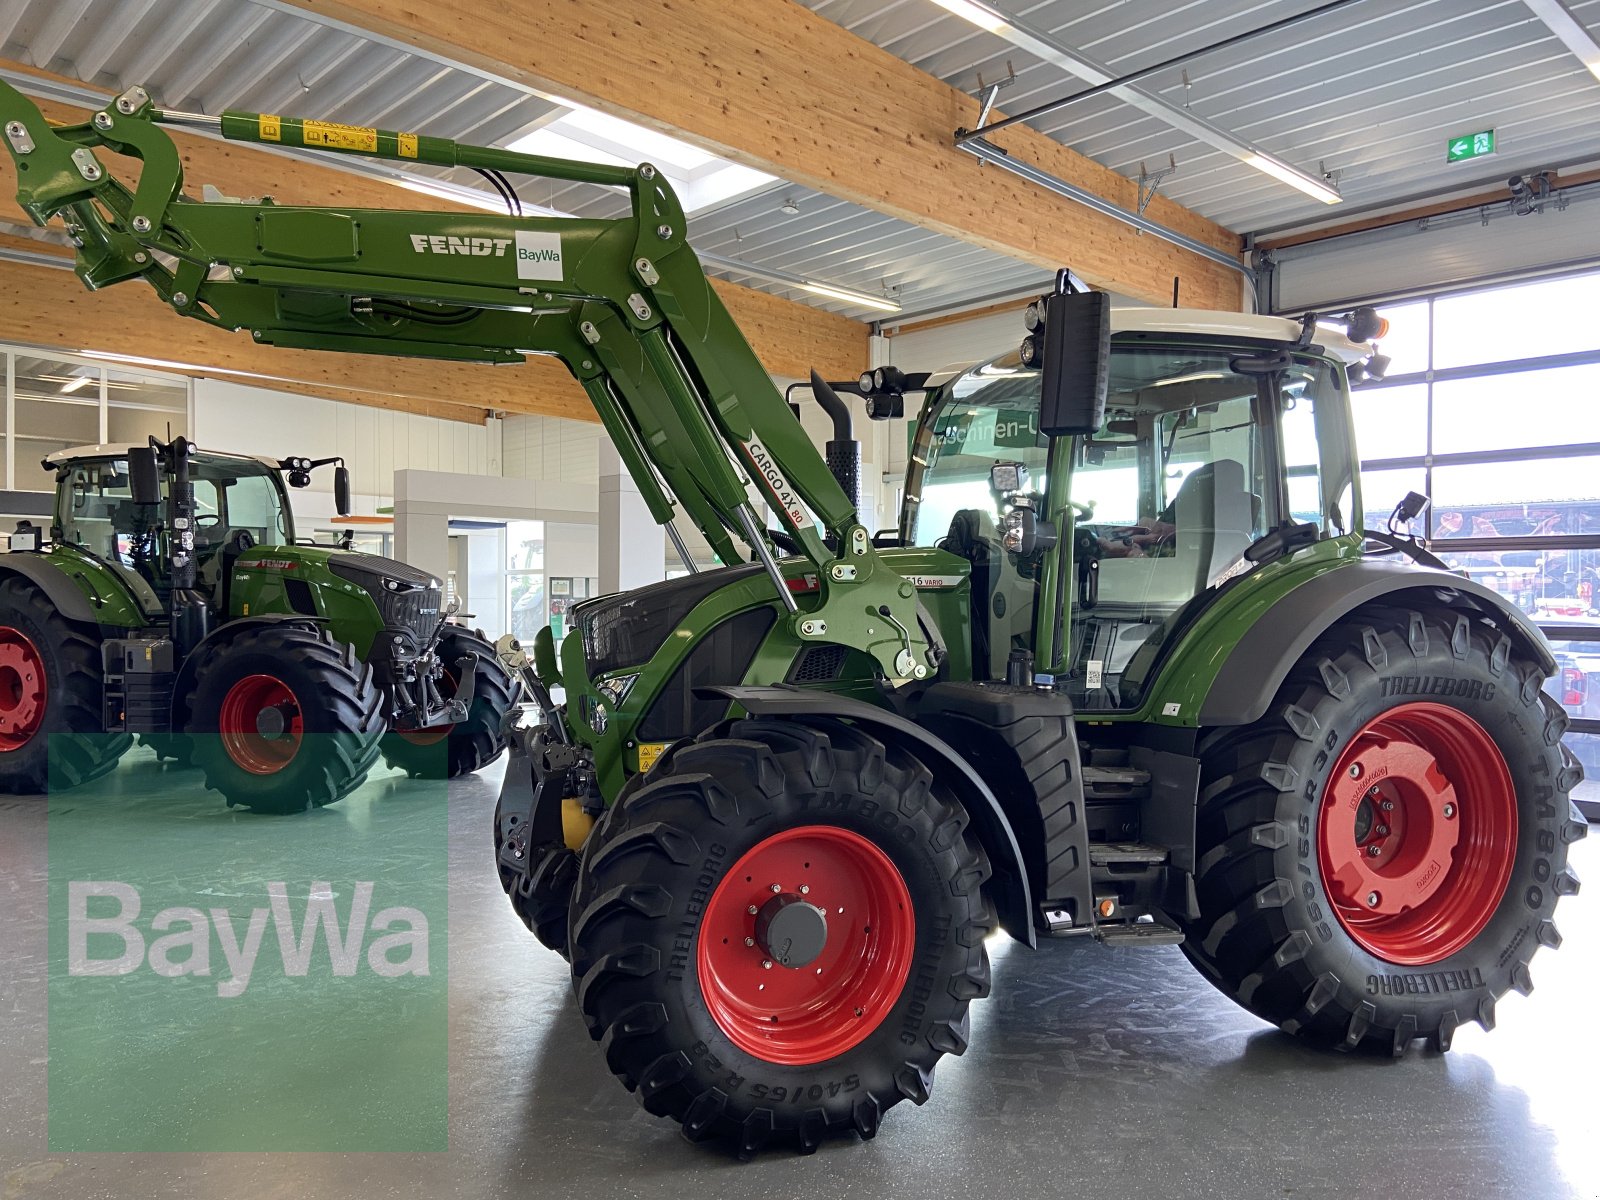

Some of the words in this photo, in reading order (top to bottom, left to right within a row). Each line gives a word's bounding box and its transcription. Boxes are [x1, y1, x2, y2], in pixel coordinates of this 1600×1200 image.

[409, 234, 513, 257] FENDT
[518, 248, 561, 263] BayWa
[749, 444, 784, 491] CARGO
[781, 491, 797, 510] 4X
[791, 509, 804, 524] 80
[260, 558, 292, 569] FENDT
[1378, 675, 1496, 702] TRELLEBORG
[1303, 779, 1318, 803] R
[1313, 729, 1339, 772] 38
[796, 791, 917, 842] TM800
[1525, 755, 1556, 910] TM800
[665, 842, 727, 984] TRELLEBORG
[900, 913, 953, 1046] TRELLEBORG
[1365, 967, 1487, 997] TRELLEBORG
[692, 1040, 723, 1074] 28
[725, 1069, 745, 1091] R
[748, 1073, 861, 1105] 540/65
